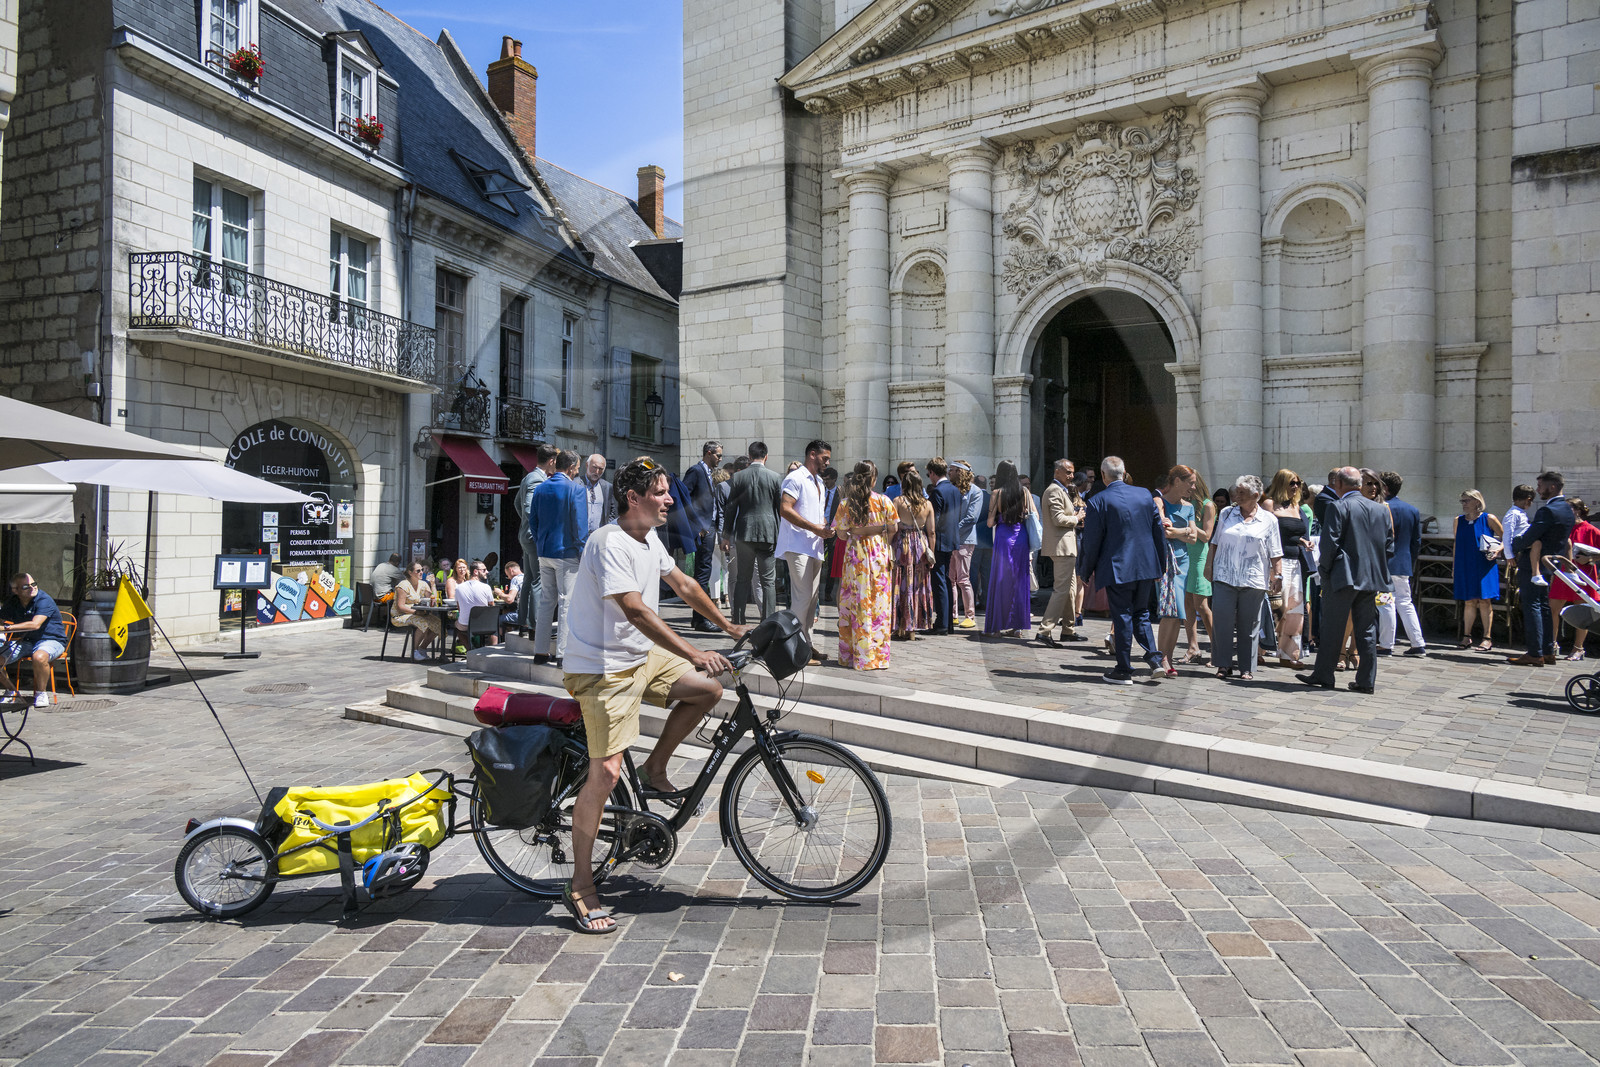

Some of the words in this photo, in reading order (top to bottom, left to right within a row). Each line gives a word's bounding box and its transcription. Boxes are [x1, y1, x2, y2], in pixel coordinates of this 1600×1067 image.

[212, 374, 283, 411] AUTO
[270, 425, 285, 440] de
[290, 427, 350, 479] CONDUITE
[262, 465, 320, 477] LEGER-HUPONT
[469, 481, 495, 490] RESTAURANT
